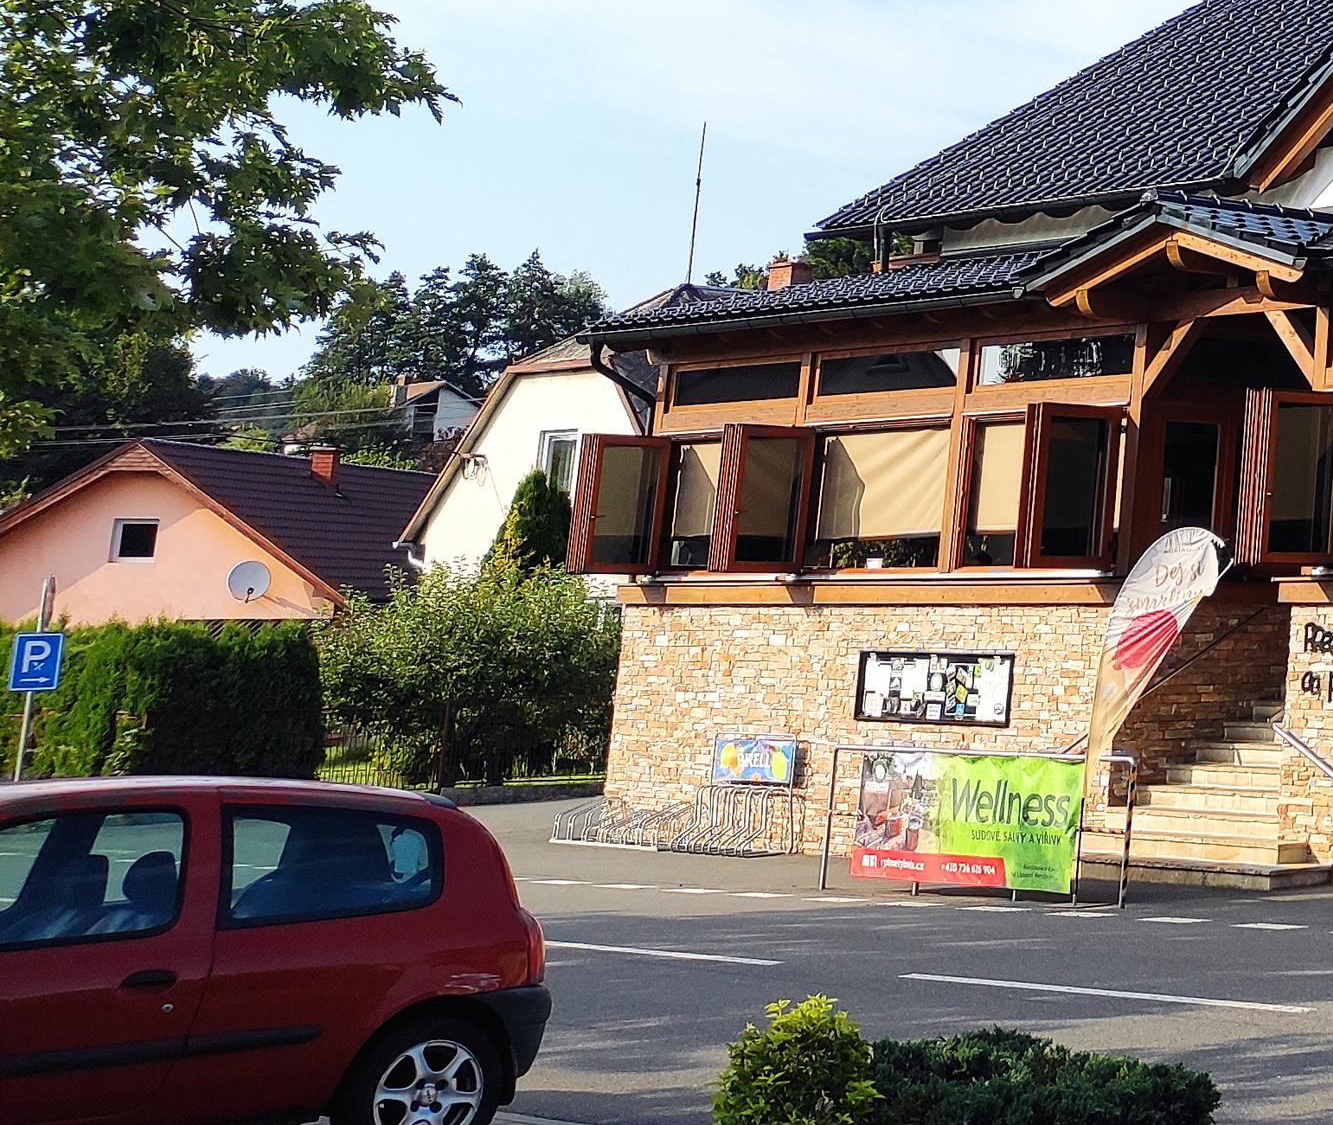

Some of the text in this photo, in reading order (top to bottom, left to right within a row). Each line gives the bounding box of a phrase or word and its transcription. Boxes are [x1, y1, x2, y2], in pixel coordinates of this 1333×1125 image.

[1155, 562, 1184, 588] Dej
[21, 640, 52, 673] P
[1301, 671, 1321, 700] a
[952, 778, 1070, 827] Wellness
